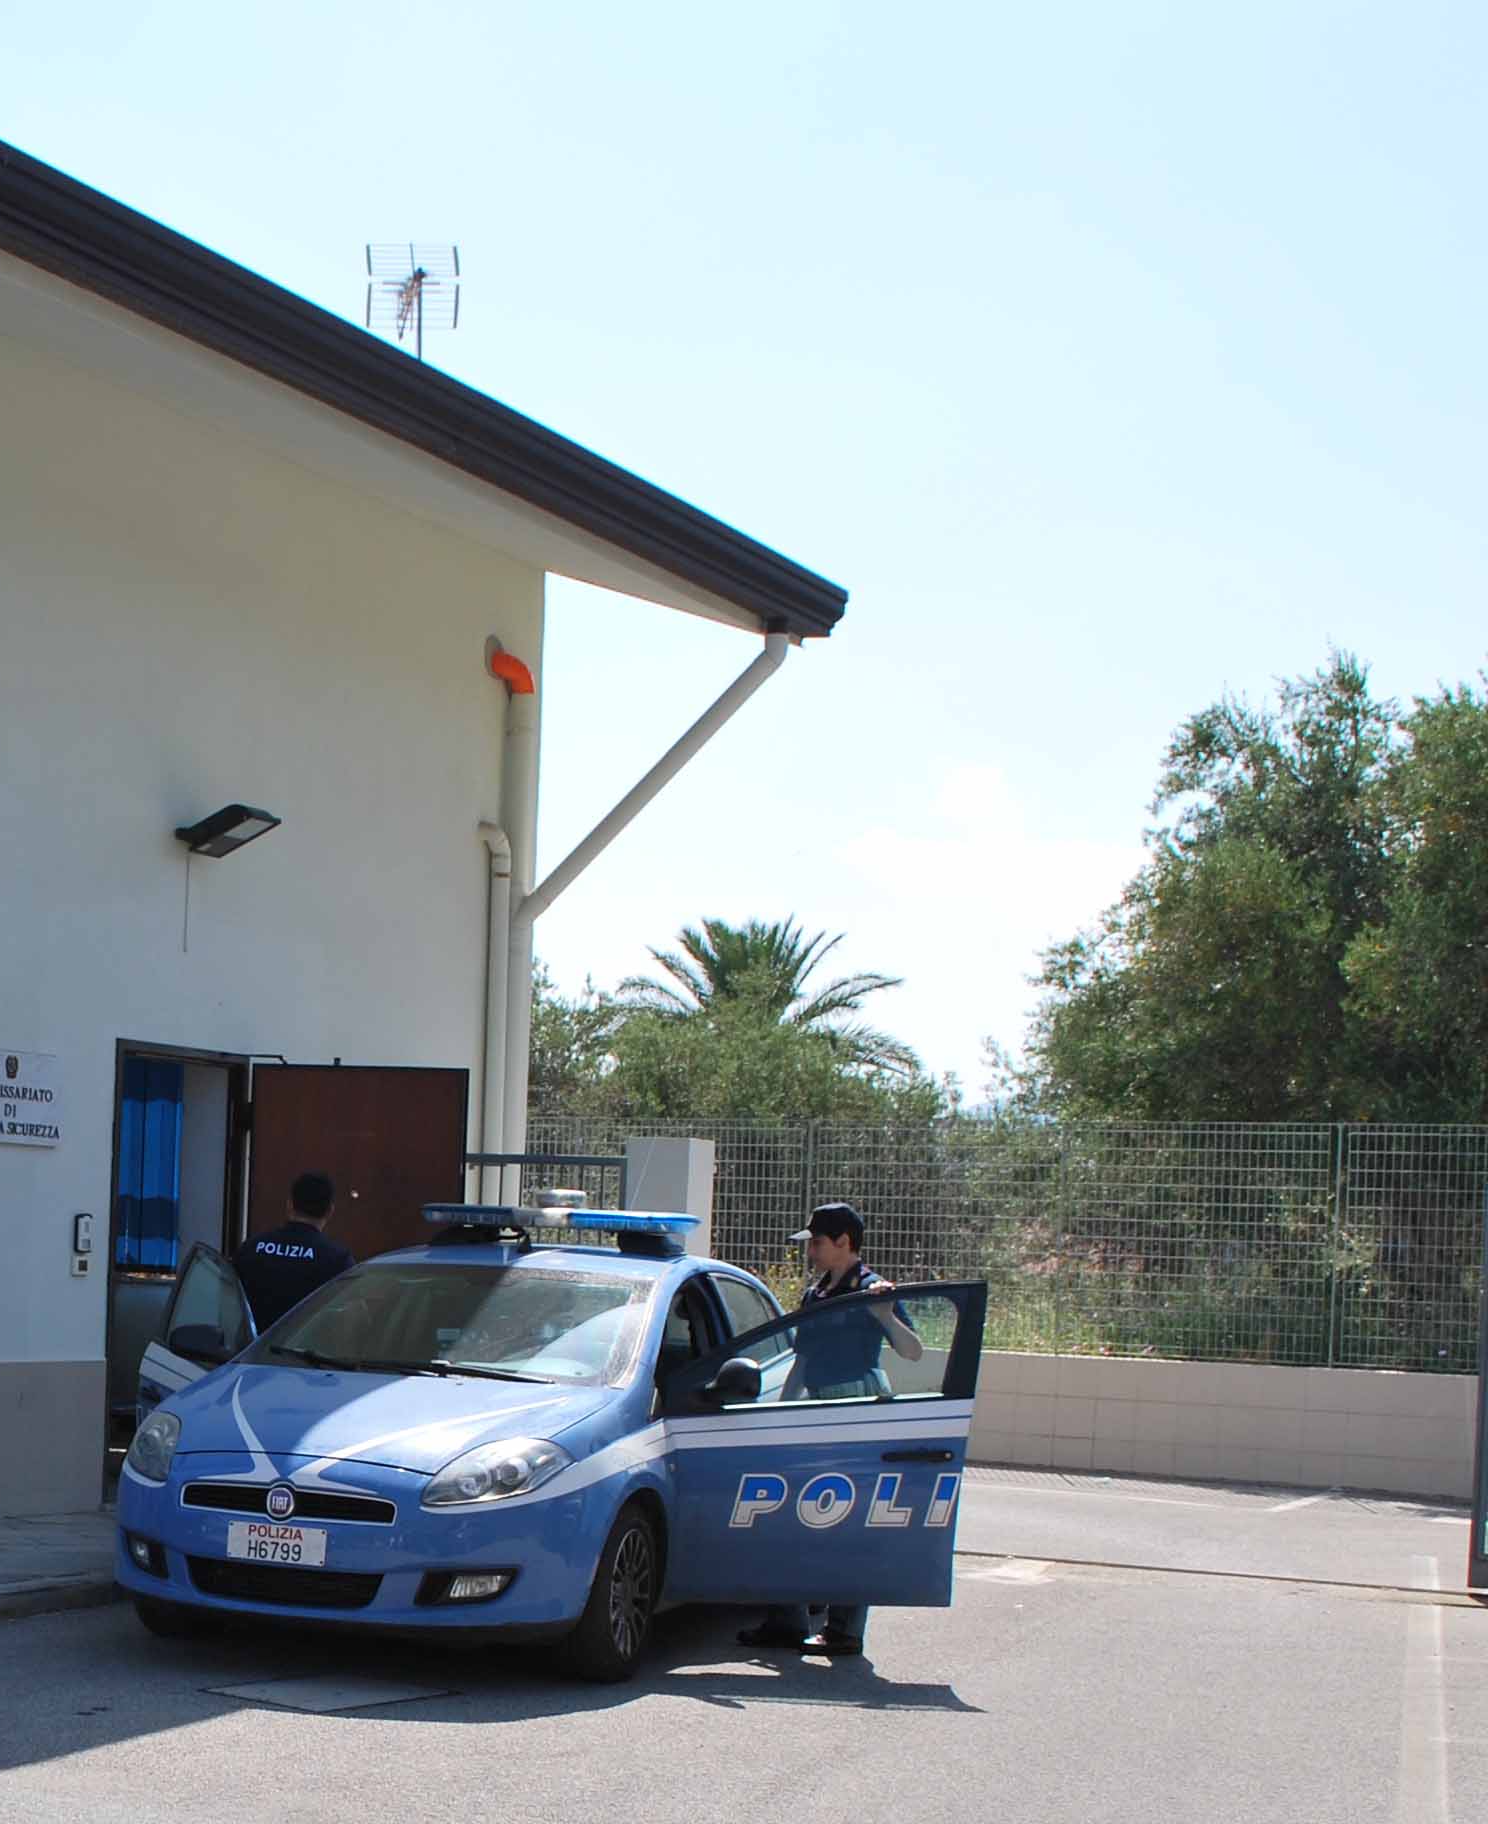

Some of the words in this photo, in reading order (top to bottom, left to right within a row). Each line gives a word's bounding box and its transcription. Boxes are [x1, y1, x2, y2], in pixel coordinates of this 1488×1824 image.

[4, 1103, 17, 1118] DI
[6, 1121, 60, 1140] SICUREZZA
[255, 1241, 314, 1259] POLIZIA
[272, 1495, 288, 1511] FIAT
[728, 1472, 962, 1529] POLI
[247, 1524, 304, 1541] POLIZIA
[247, 1540, 303, 1562] H6799
